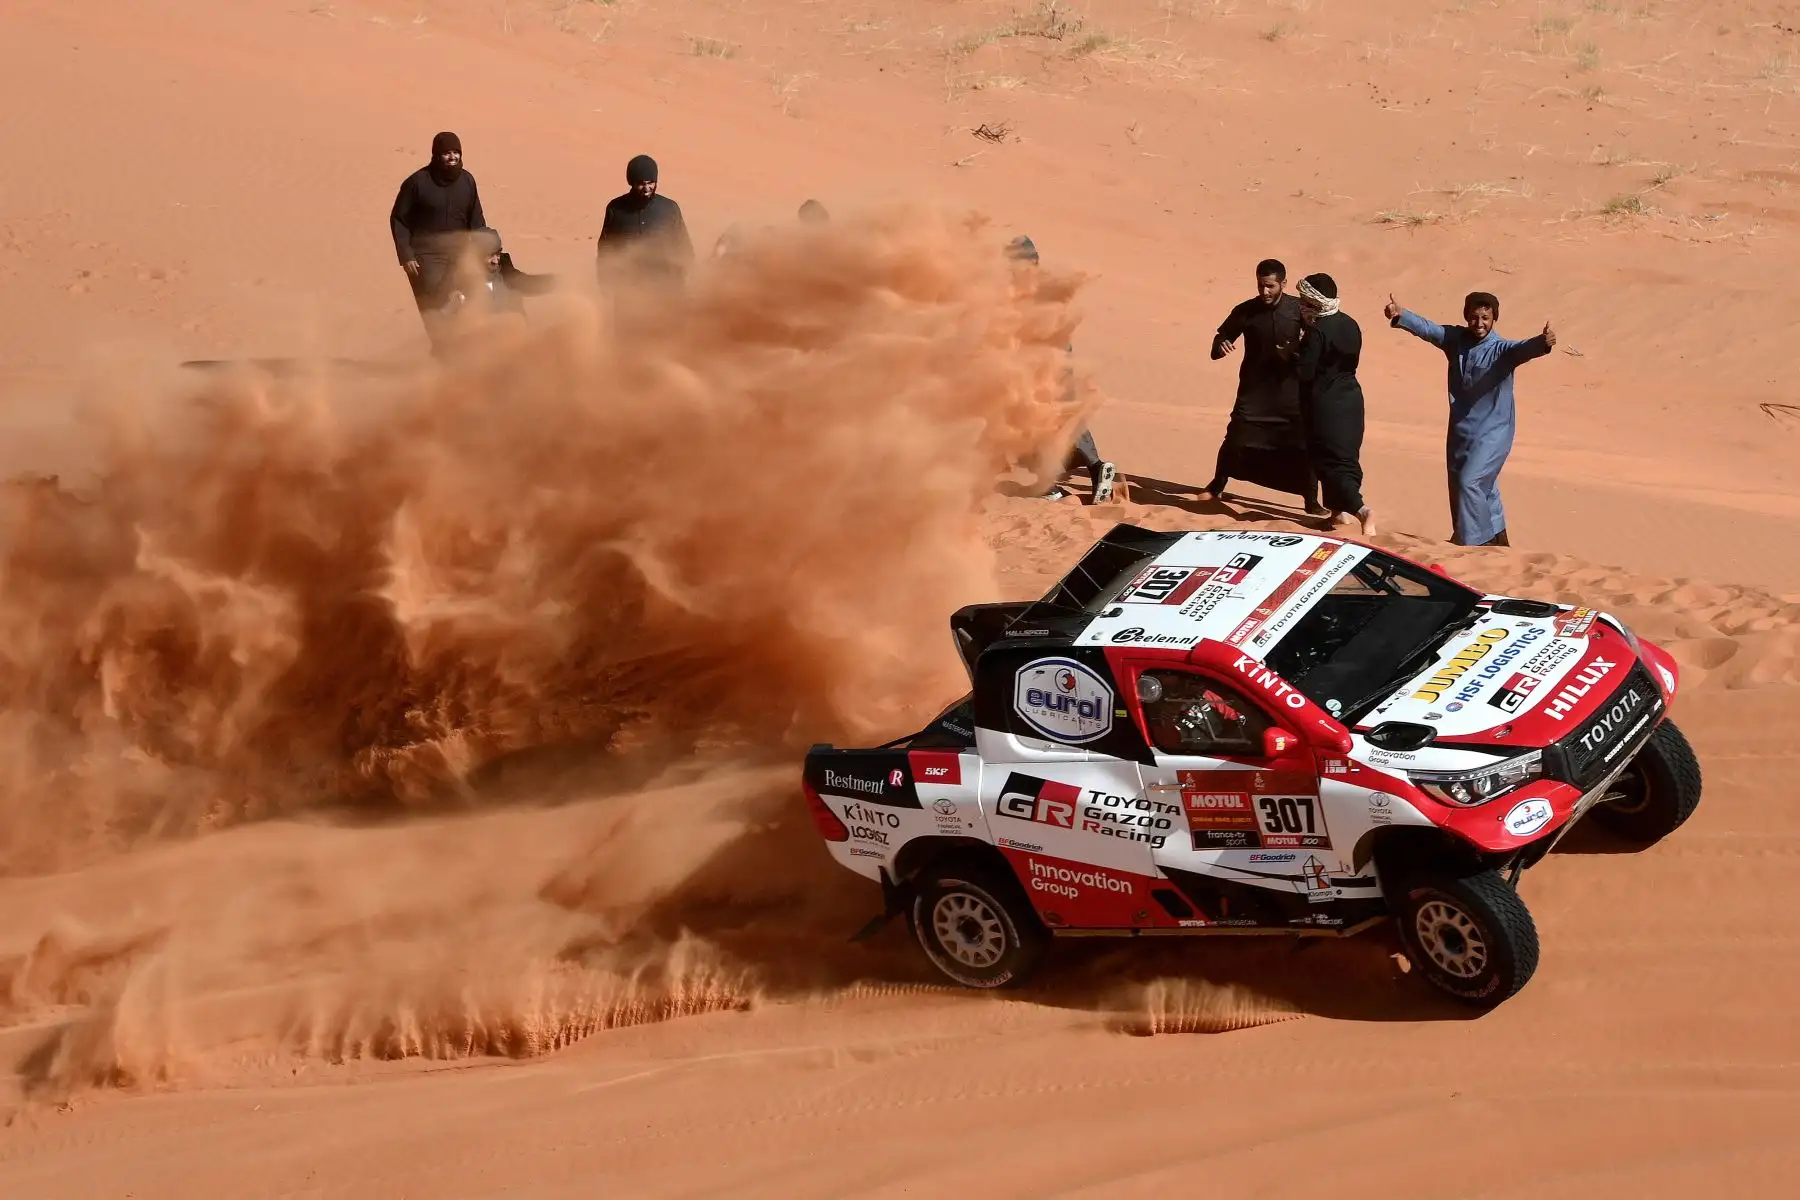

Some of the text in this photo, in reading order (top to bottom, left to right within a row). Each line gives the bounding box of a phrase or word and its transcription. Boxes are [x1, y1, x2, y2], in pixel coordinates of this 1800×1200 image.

[1213, 552, 1252, 584] GR
[1132, 569, 1190, 601] 307
[1178, 584, 1215, 615] Racing
[1270, 603, 1303, 633] TOYOTA
[1299, 576, 1330, 604] GAZOO
[1327, 553, 1356, 579] Racing
[1189, 585, 1223, 618] GAZOO
[1194, 587, 1233, 622] TOYOTA
[1111, 627, 1197, 645] Beelen.nl
[1230, 619, 1258, 644] MOTUL
[1410, 627, 1510, 704] JUMBO
[1455, 627, 1546, 702] HSF LOGISTICS
[1520, 638, 1562, 671] TOYOTA
[1530, 643, 1567, 674] GAZOO
[1540, 647, 1578, 677] Racing
[1500, 674, 1542, 713] GR
[1544, 655, 1617, 721] HILUX
[1026, 688, 1103, 722] eurol
[1580, 688, 1641, 752] TOYOTA
[1368, 755, 1390, 765] Group
[1370, 748, 1416, 761] Innovation
[824, 769, 885, 795] Restment
[924, 767, 949, 776] SKF
[998, 791, 1073, 828] GR
[1088, 790, 1181, 816] TOYOTA
[1190, 794, 1245, 808] MOTUL
[1259, 797, 1316, 834] 307
[1368, 807, 1393, 815] TOYOTA
[1083, 806, 1172, 830] GAZOO
[998, 837, 1044, 852] BFGoodrich
[1081, 819, 1167, 849] Racing
[1225, 838, 1248, 847] sport
[1266, 837, 1299, 845] MOTUL
[1249, 853, 1296, 862] BFGoodrich
[1028, 858, 1133, 895] Innovation
[1031, 877, 1079, 900] Group
